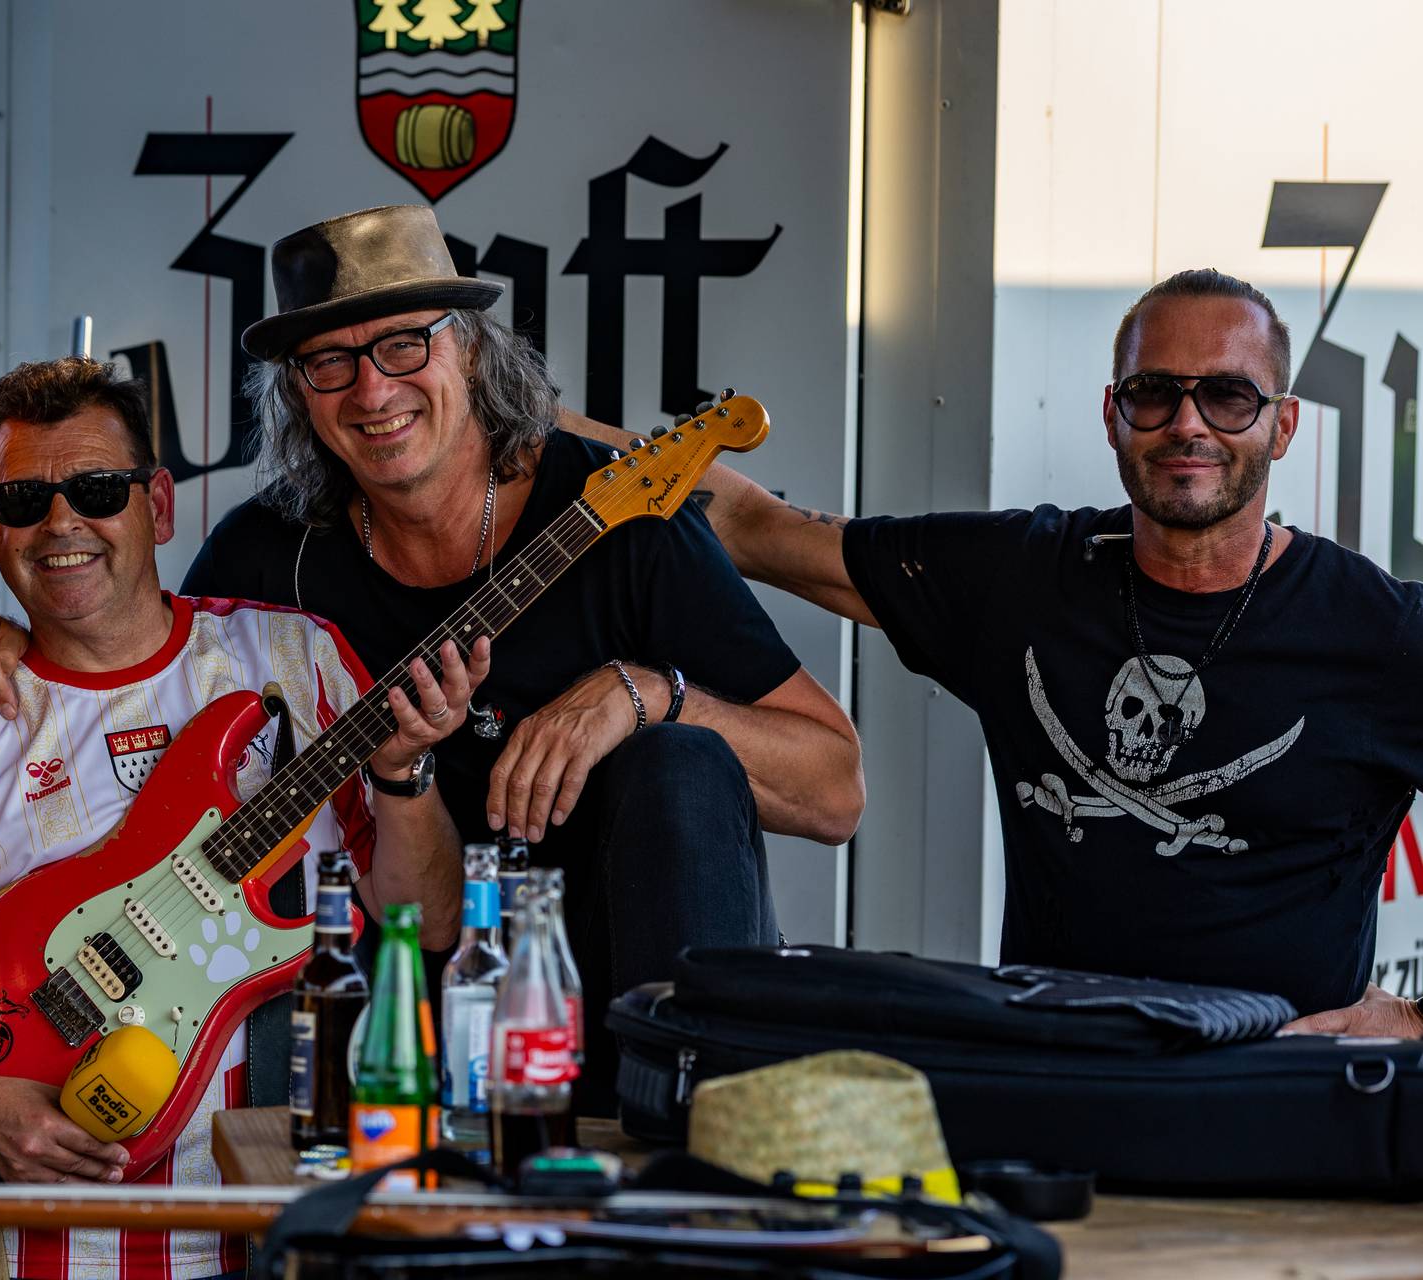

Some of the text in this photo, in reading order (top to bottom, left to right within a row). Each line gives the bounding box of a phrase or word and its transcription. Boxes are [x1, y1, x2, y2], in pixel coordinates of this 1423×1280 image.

[110, 132, 783, 483] Znft
[647, 472, 681, 512] Fender
[26, 776, 71, 802] hummel
[88, 1095, 117, 1125] Berg
[94, 1084, 128, 1118] Radio
